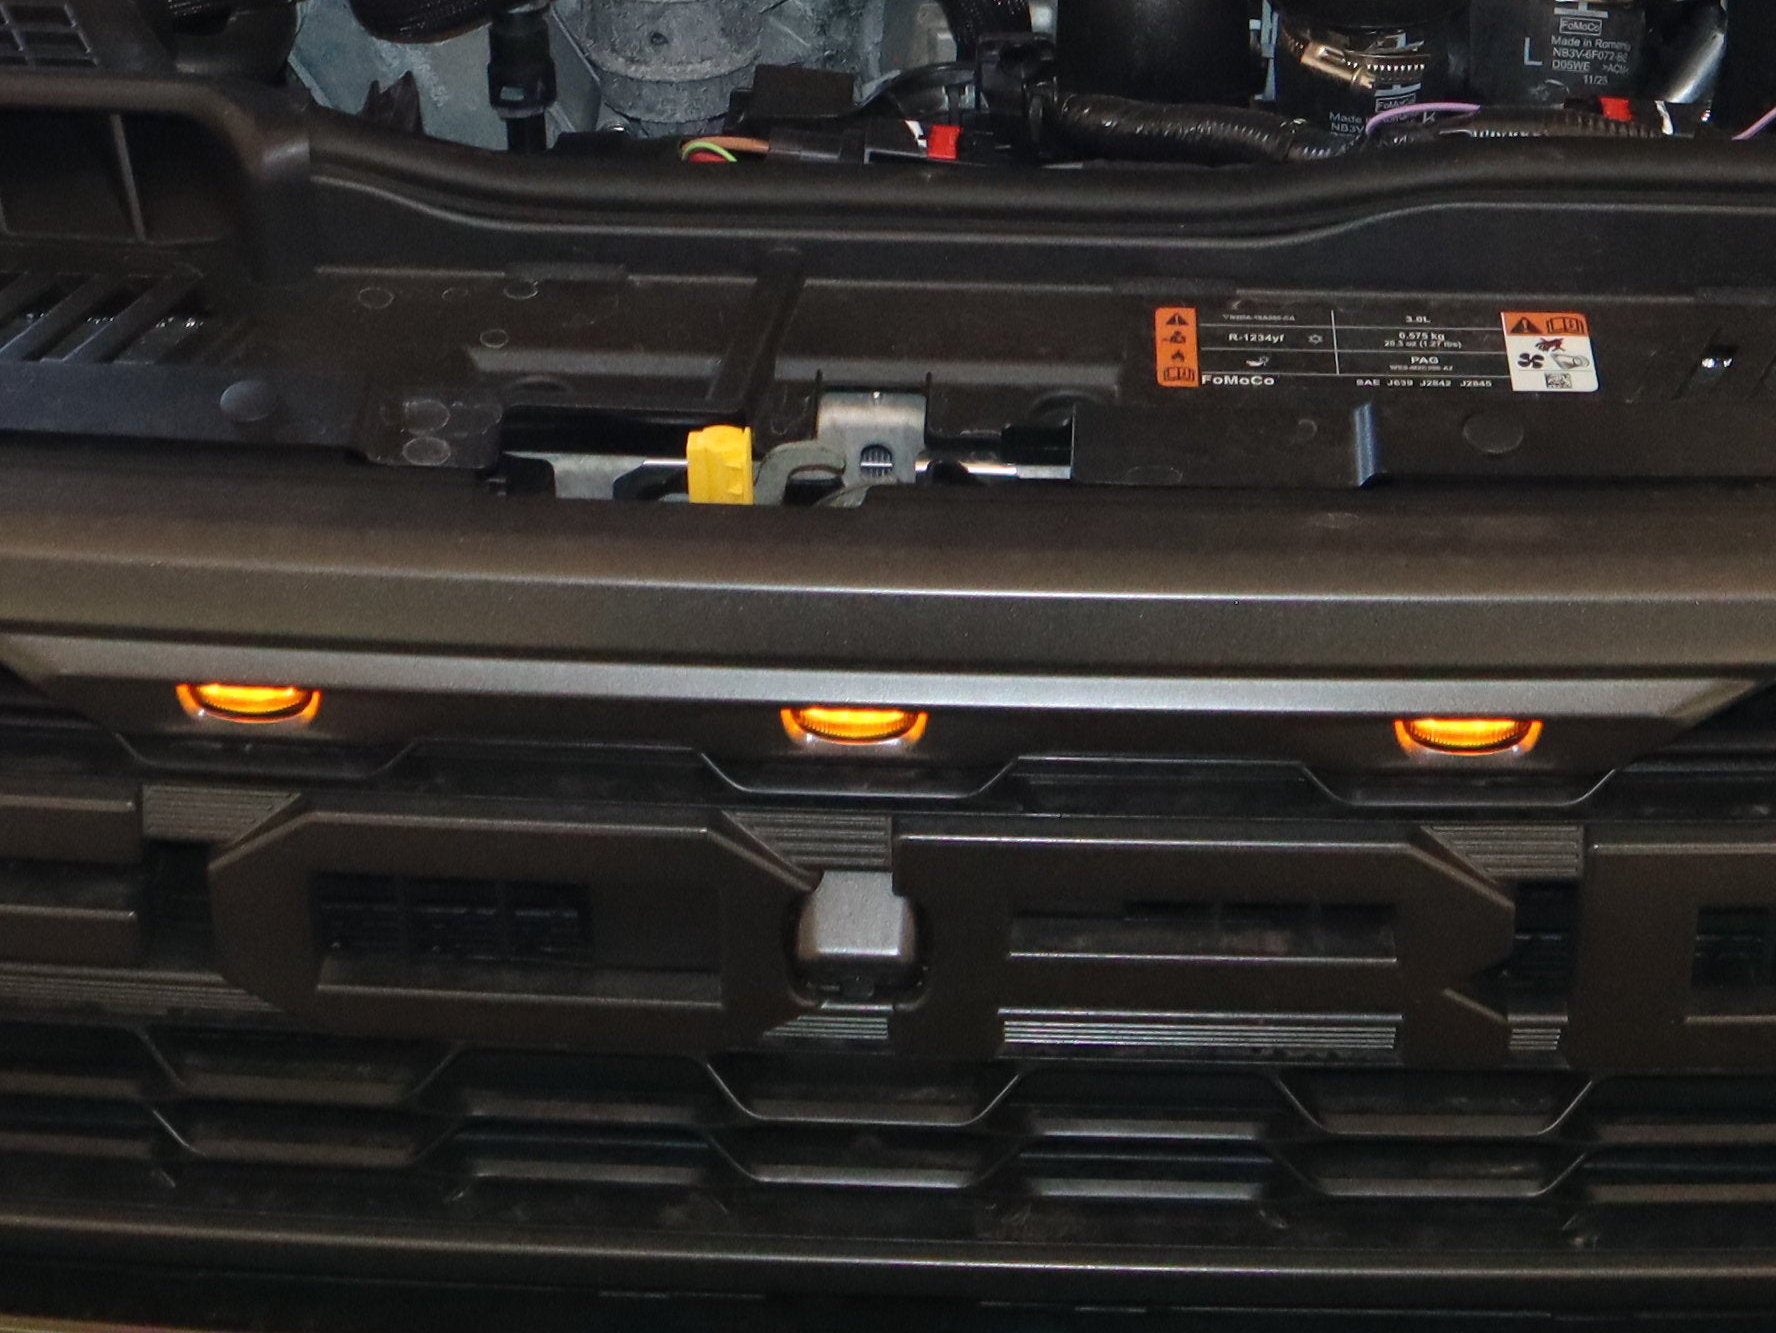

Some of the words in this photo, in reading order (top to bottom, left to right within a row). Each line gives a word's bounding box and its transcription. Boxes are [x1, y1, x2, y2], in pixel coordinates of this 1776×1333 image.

[1551, 35, 1581, 46] Made
[1583, 37, 1592, 46] in
[1523, 36, 1544, 66] L
[1228, 332, 1286, 344] R-1234yf
[1410, 356, 1439, 365] PAG
[1201, 374, 1275, 386] FoMoCo
